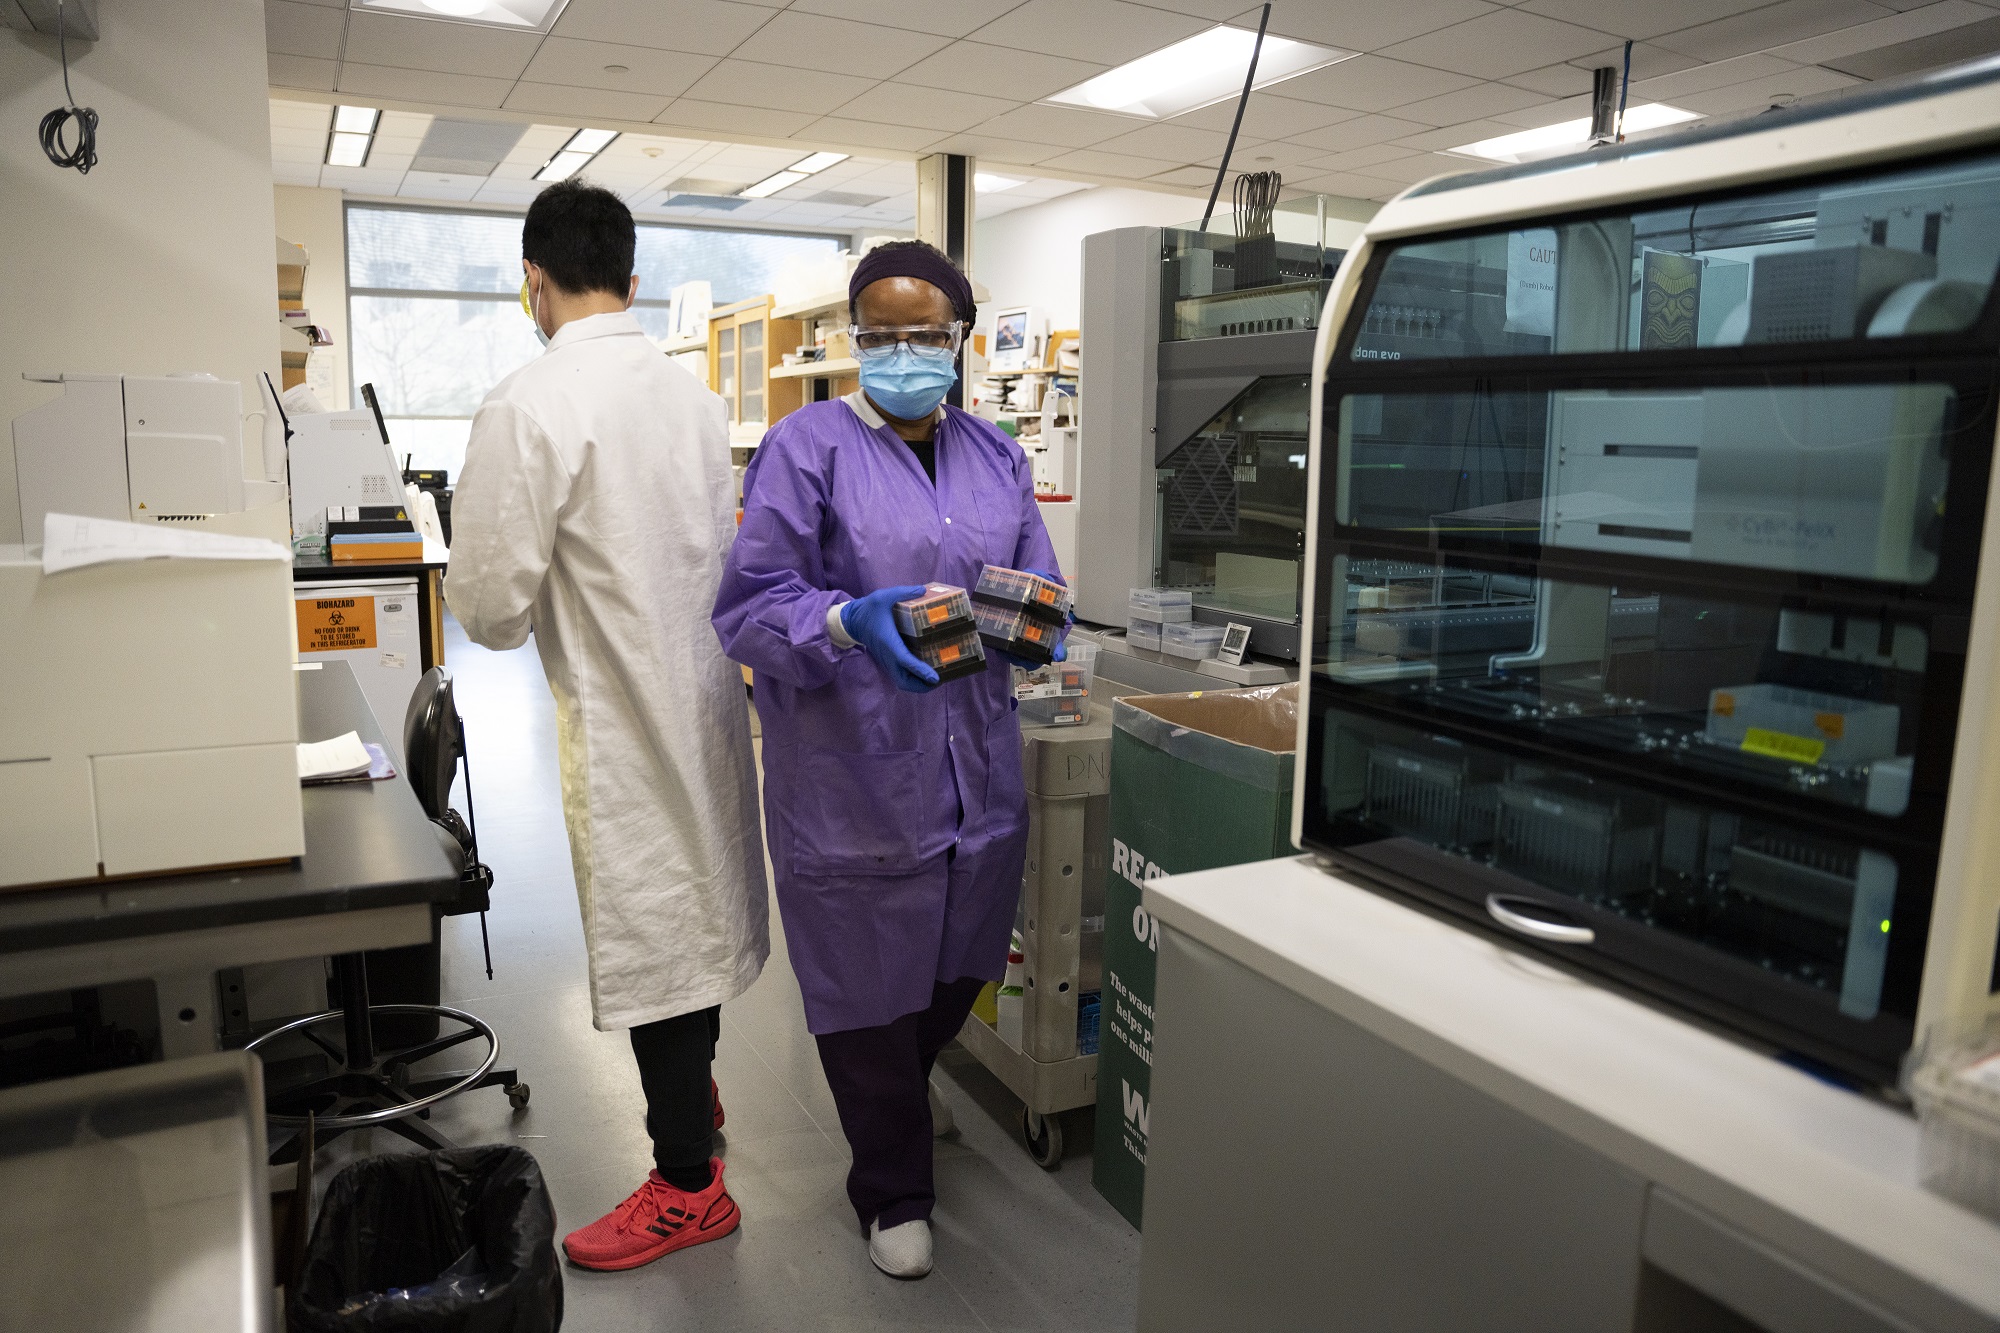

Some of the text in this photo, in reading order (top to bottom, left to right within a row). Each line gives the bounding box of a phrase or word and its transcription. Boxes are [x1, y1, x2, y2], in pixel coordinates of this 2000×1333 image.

[1530, 246, 1556, 265] CAUT
[1380, 350, 1400, 360] evo
[316, 599, 355, 609] BIOHAZARD
[329, 638, 366, 647] REFRIGERATOR
[1067, 752, 1110, 781] DN
[1112, 837, 1170, 891] REC
[1110, 971, 1127, 997] The
[1116, 999, 1143, 1034] helps
[1110, 1020, 1128, 1044] one
